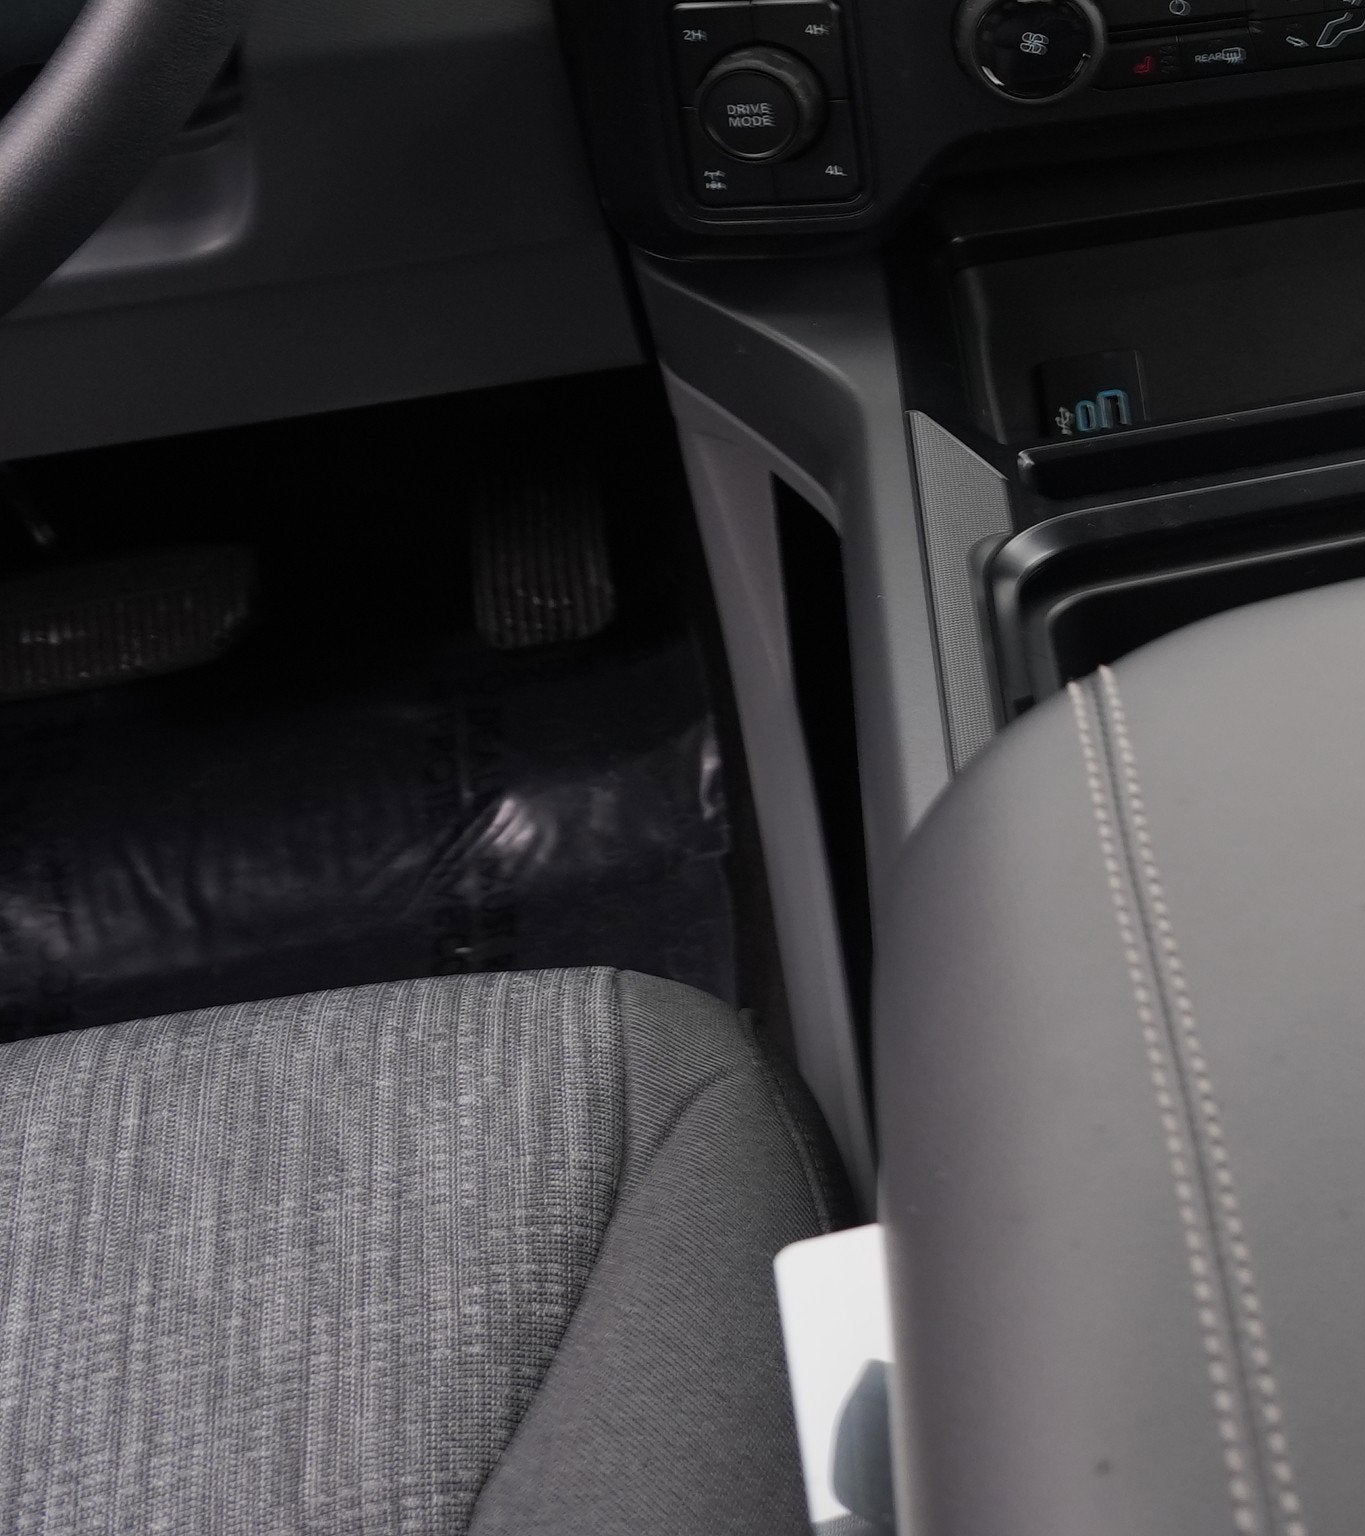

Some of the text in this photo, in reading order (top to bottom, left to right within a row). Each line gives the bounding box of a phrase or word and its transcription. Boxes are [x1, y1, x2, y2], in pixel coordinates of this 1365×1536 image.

[683, 29, 707, 41] 2H
[805, 24, 829, 35] 4H
[1194, 52, 1222, 63] REAR
[727, 102, 773, 115] DRIVE
[729, 115, 775, 128] MODE
[825, 165, 847, 177] 4L
